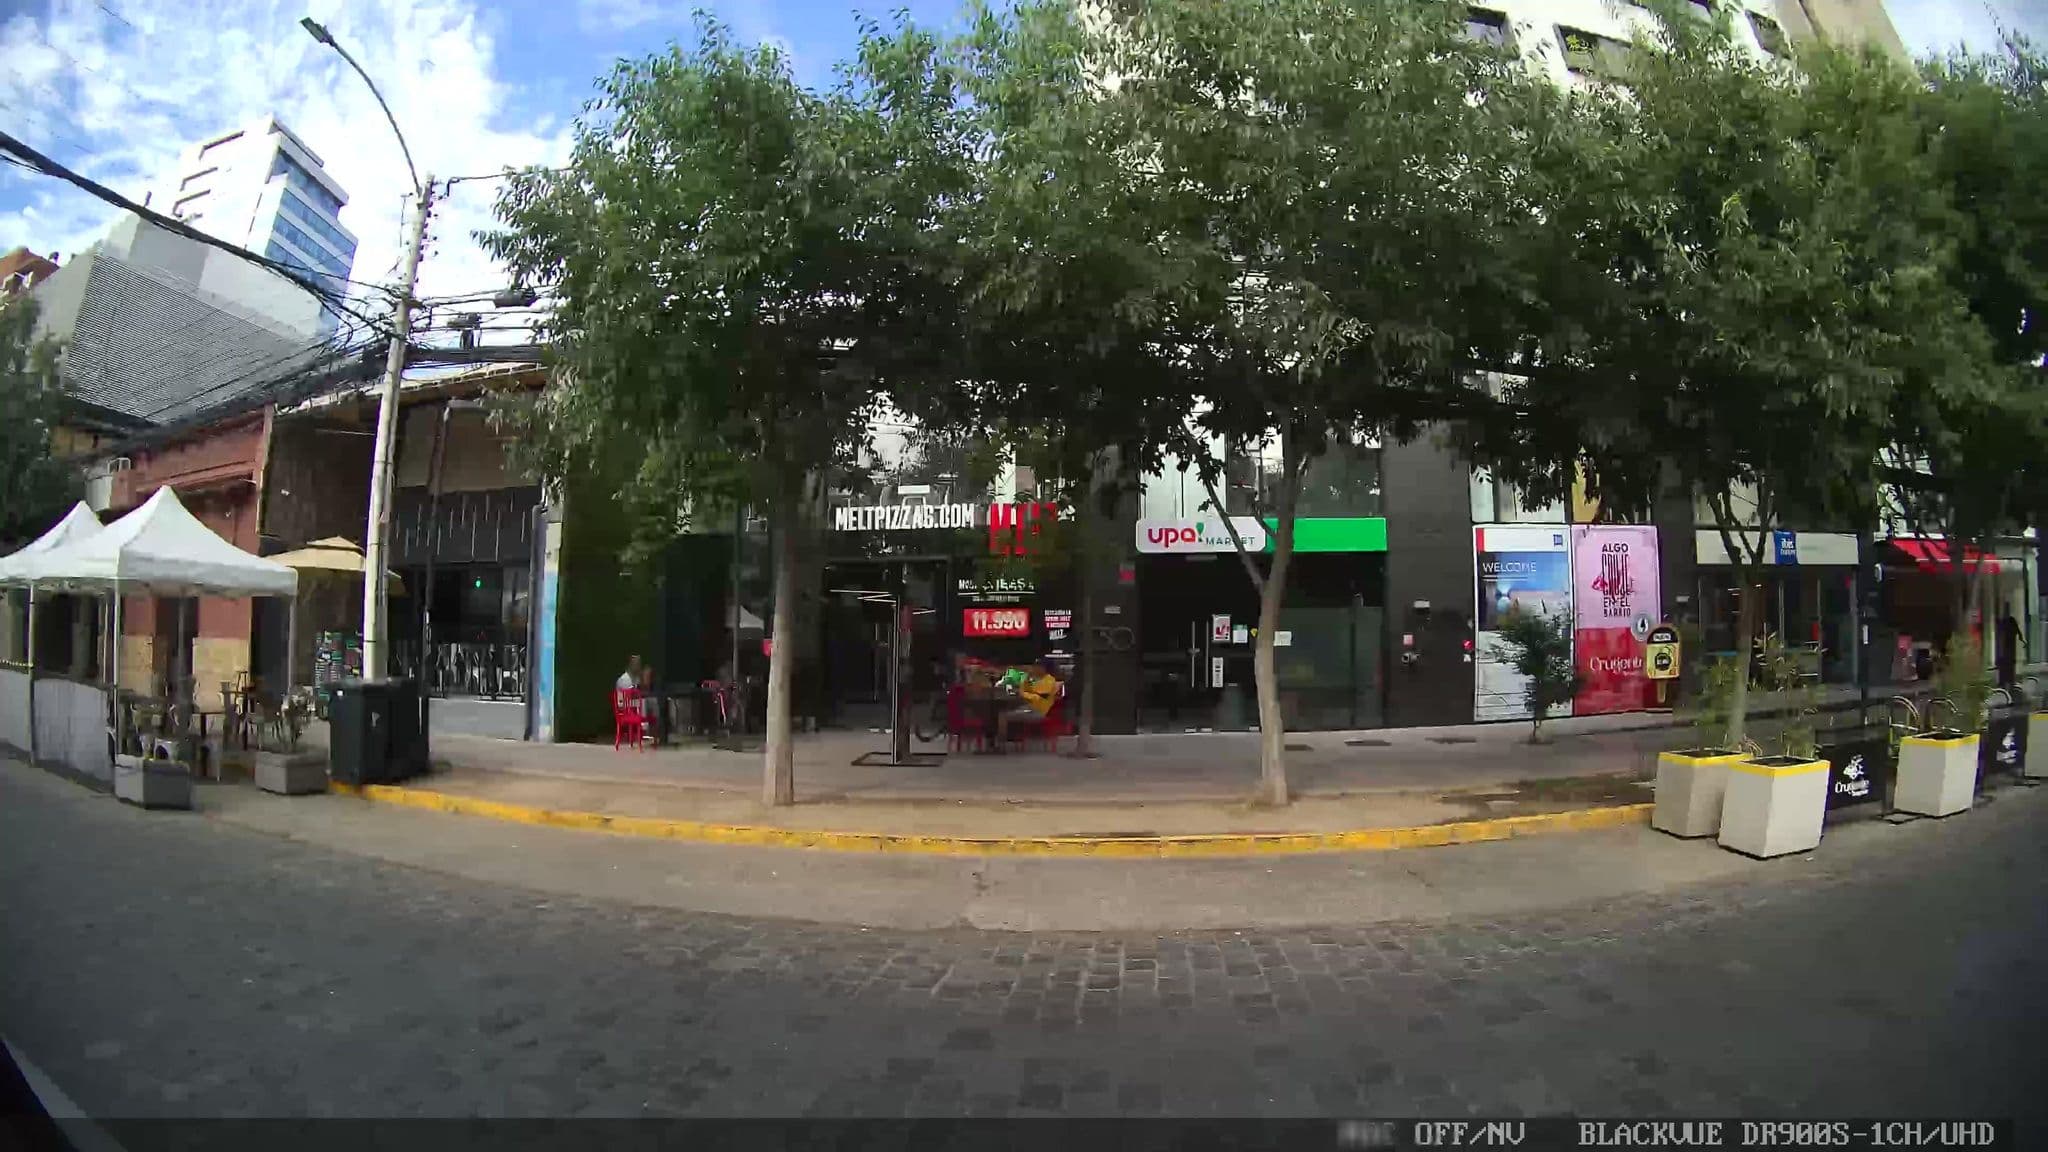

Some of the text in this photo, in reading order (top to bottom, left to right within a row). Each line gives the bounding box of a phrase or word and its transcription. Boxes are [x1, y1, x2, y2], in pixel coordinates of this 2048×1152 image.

[1206, 537, 1255, 545] MARET
[1602, 543, 1629, 552] ALGO
[1482, 562, 1537, 573] WELCOME
